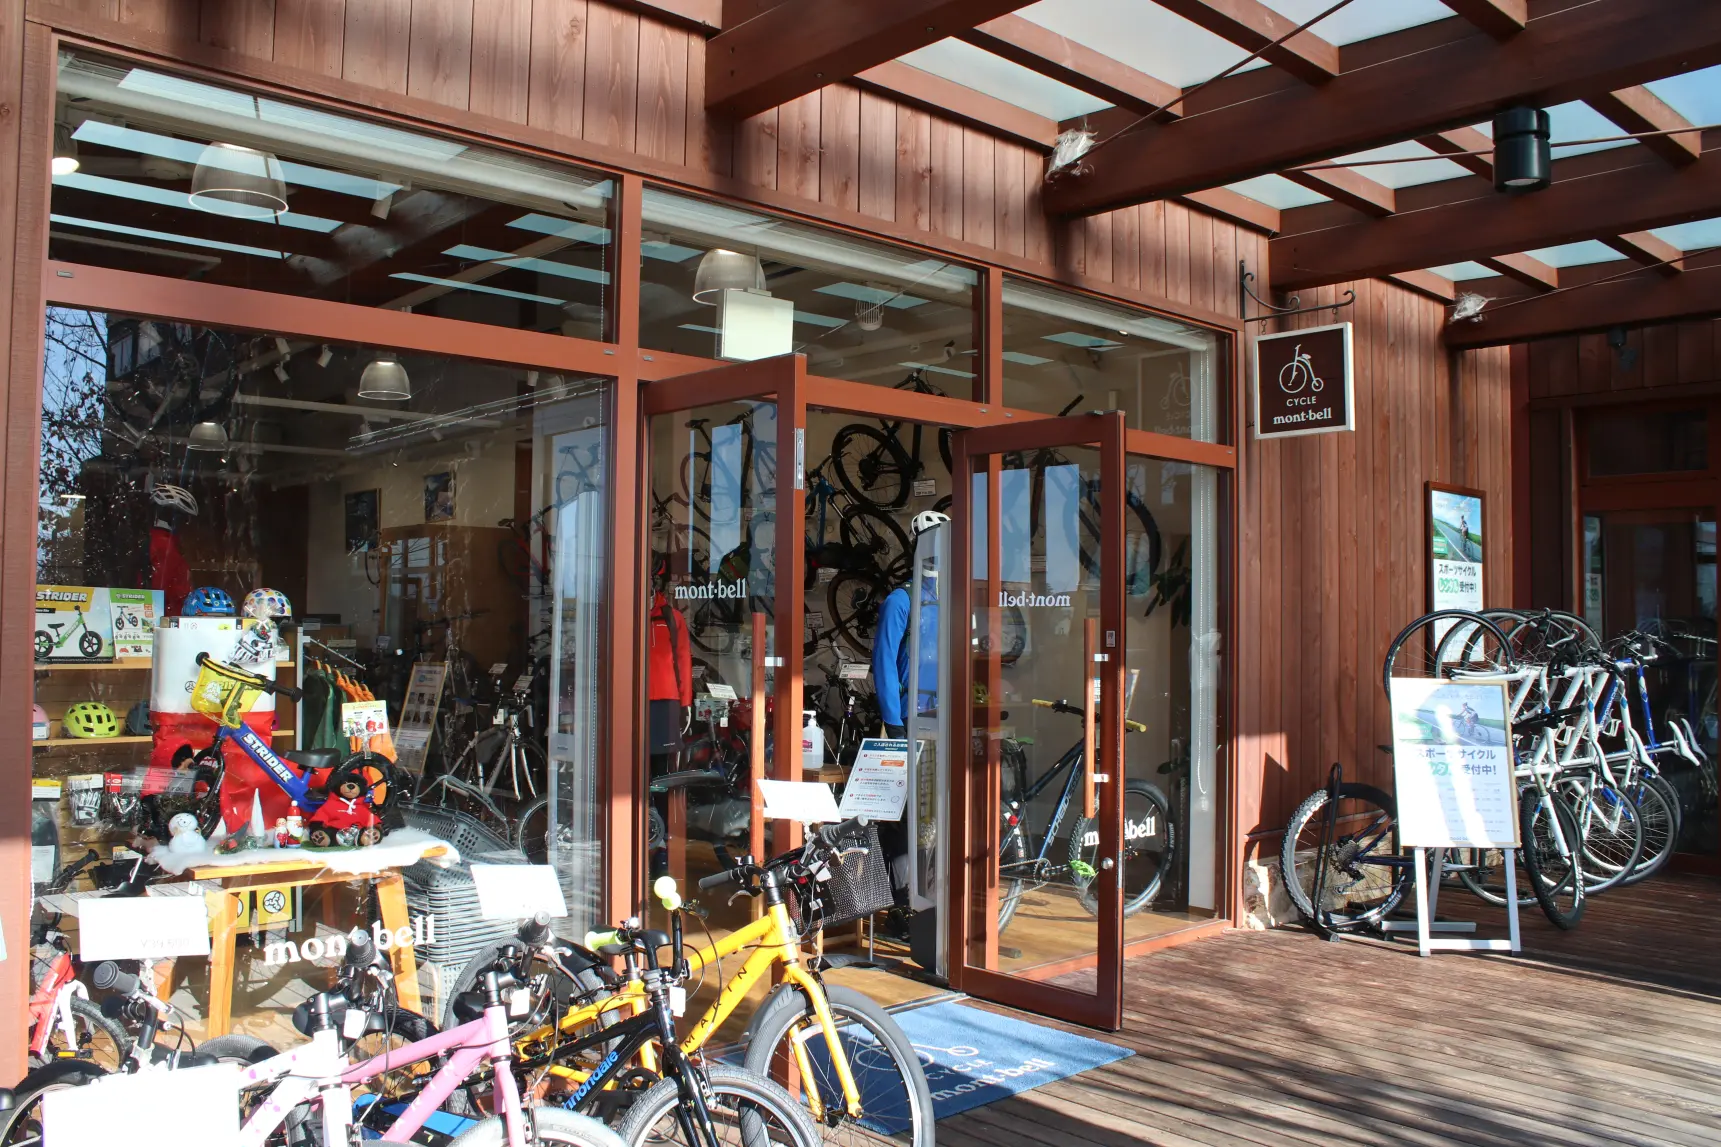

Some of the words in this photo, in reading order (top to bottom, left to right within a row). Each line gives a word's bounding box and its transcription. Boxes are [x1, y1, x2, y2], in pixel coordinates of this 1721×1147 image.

[1286, 395, 1317, 407] CYCLE
[36, 591, 88, 602] STRIDER
[241, 732, 293, 783] STRIDER
[926, 1058, 994, 1081] CYCLE
